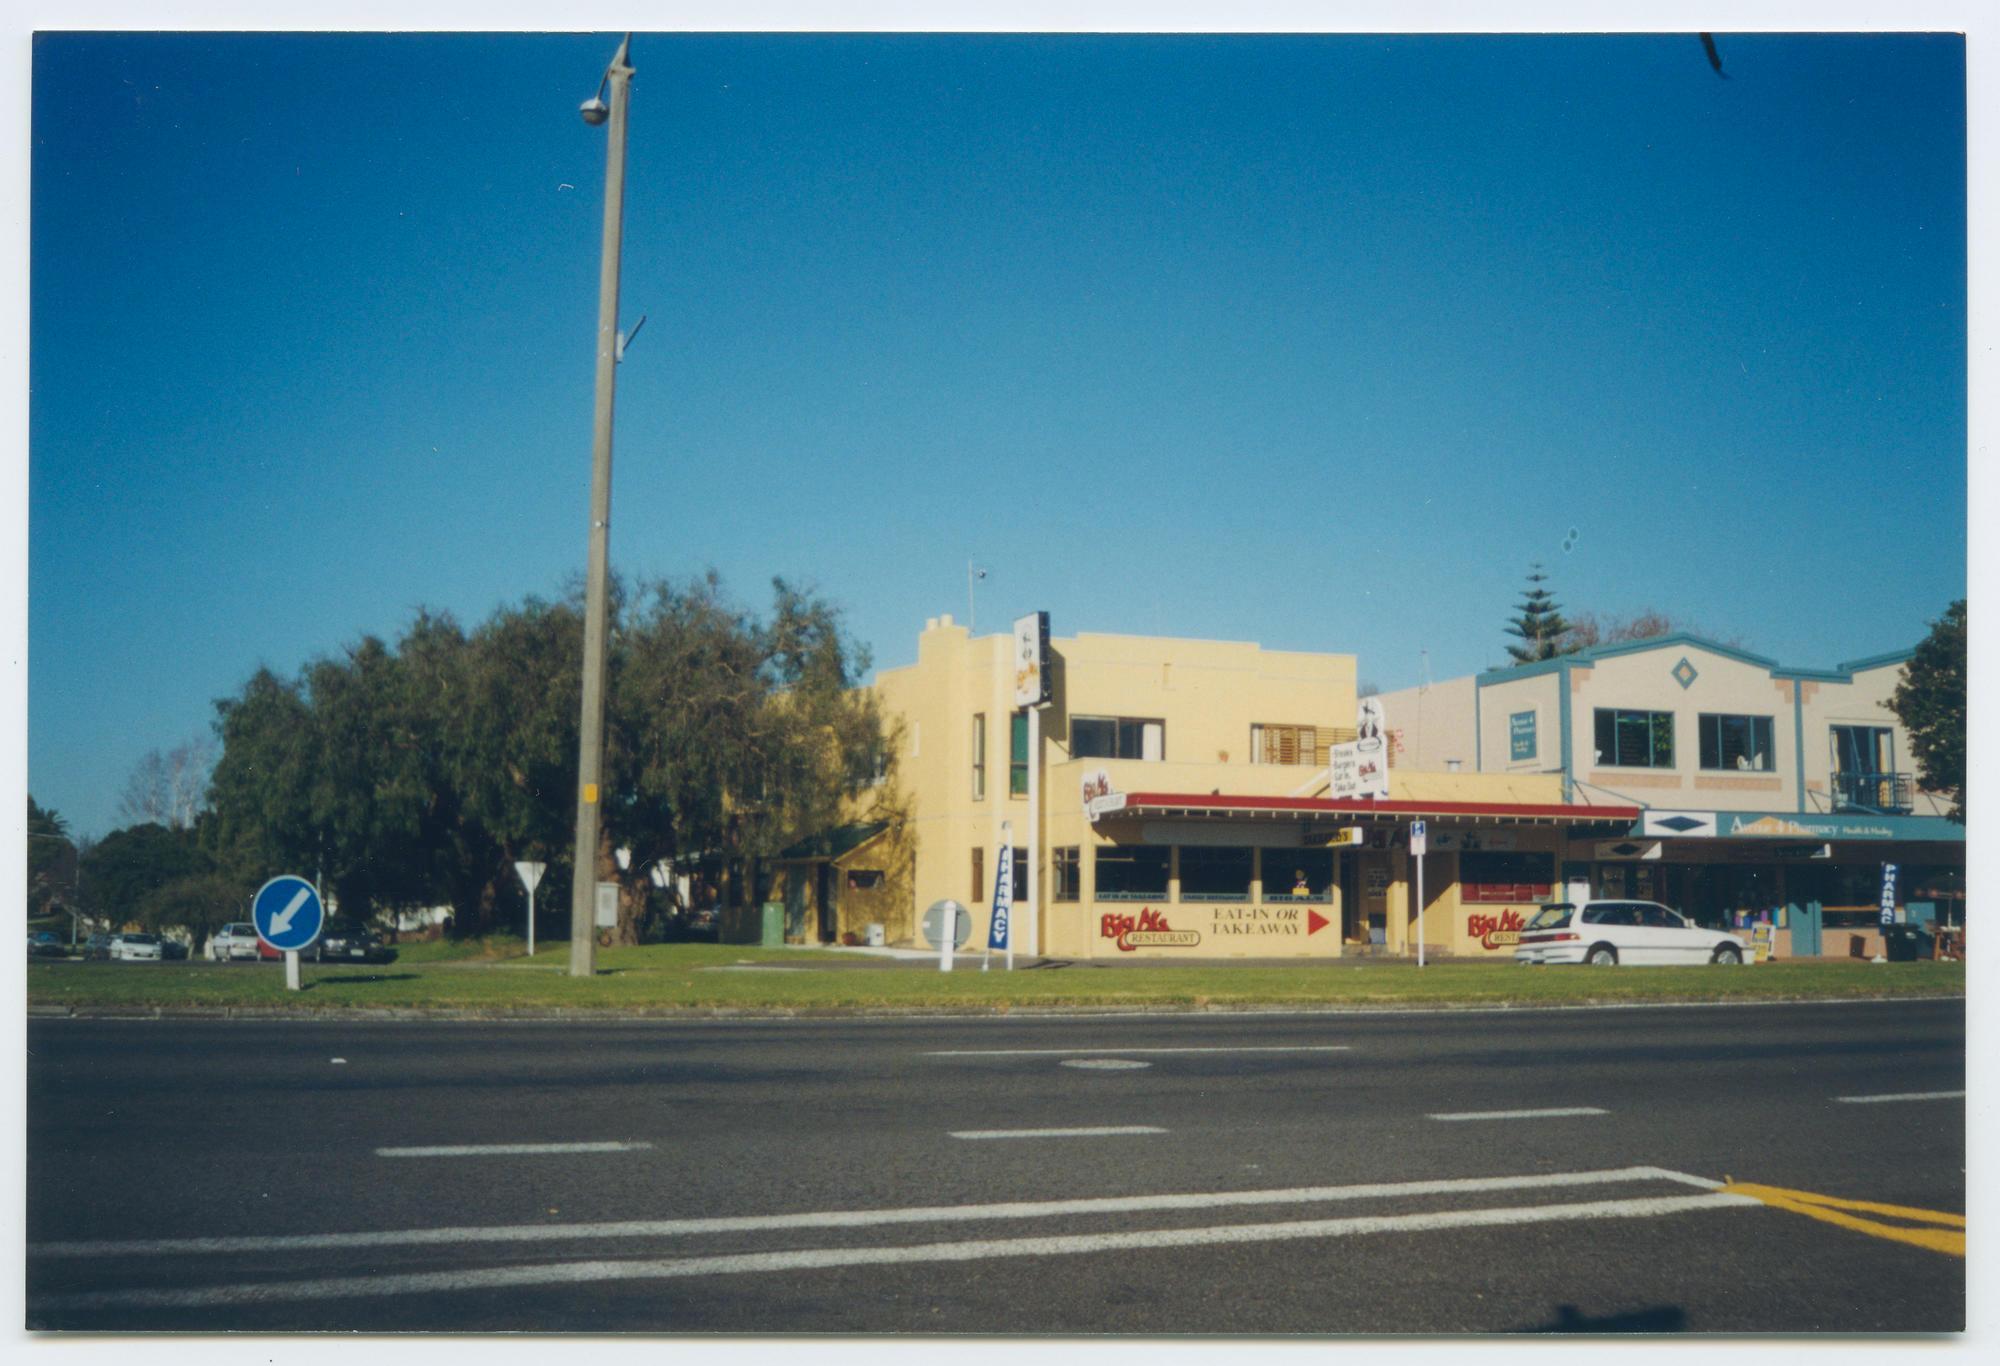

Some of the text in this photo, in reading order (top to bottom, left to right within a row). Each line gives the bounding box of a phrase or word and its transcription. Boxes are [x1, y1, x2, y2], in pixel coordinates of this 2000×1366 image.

[1788, 819, 1839, 837] Pharmacy
[1213, 908, 1299, 920] EAT-IN OR
[1101, 912, 1137, 952] Big
[1211, 923, 1299, 935] TAKEAWAY
[1131, 932, 1194, 944] RESTAURANT
